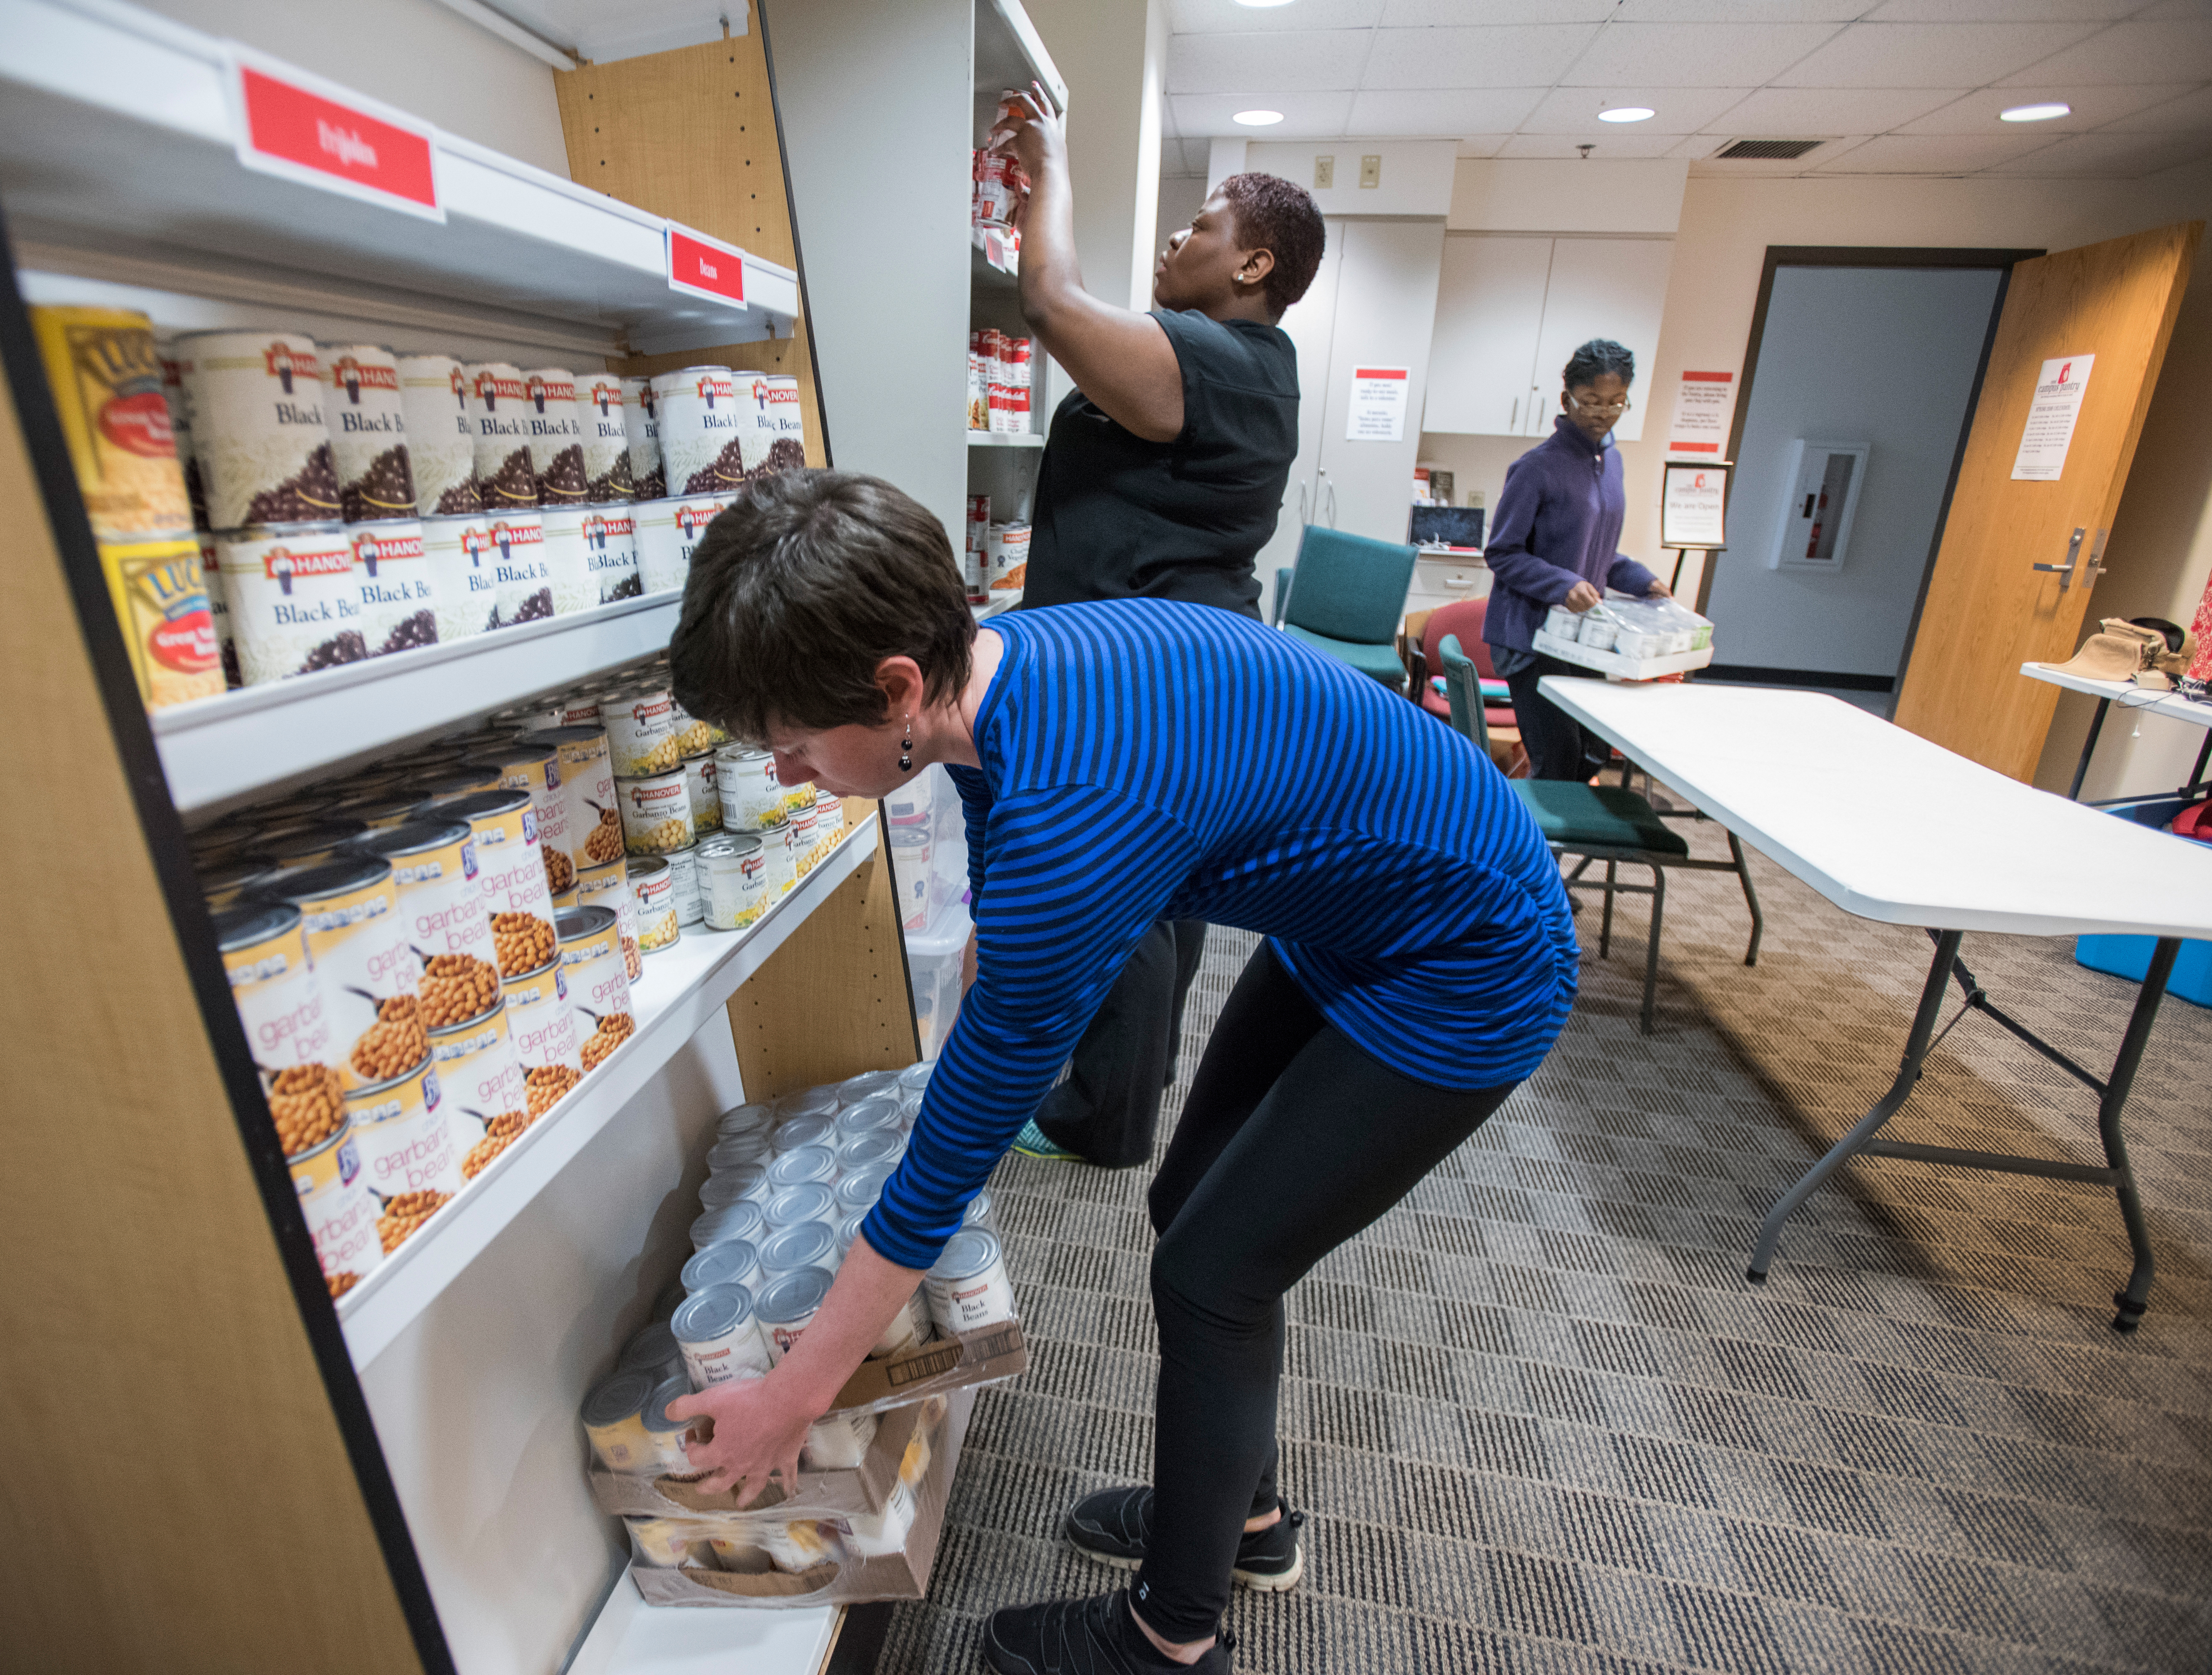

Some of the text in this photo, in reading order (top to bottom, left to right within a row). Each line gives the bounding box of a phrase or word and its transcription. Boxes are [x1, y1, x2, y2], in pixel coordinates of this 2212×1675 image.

[2059, 382, 2080, 394] pantry
[341, 411, 392, 433] Black
[480, 418, 520, 435] Black
[531, 419, 570, 435] Black
[703, 414, 733, 429] Black
[1697, 501, 1720, 511] Open
[496, 564, 537, 583] Black
[362, 582, 412, 604] Black
[273, 599, 333, 625] Black
[643, 786, 679, 798] HANOVER
[633, 810, 668, 819] Garbanzo
[669, 805, 686, 814] Beans
[961, 1299, 985, 1314] Black
[963, 1309, 989, 1322] Beans
[704, 1363, 729, 1375] Black
[707, 1373, 733, 1383] Beans
